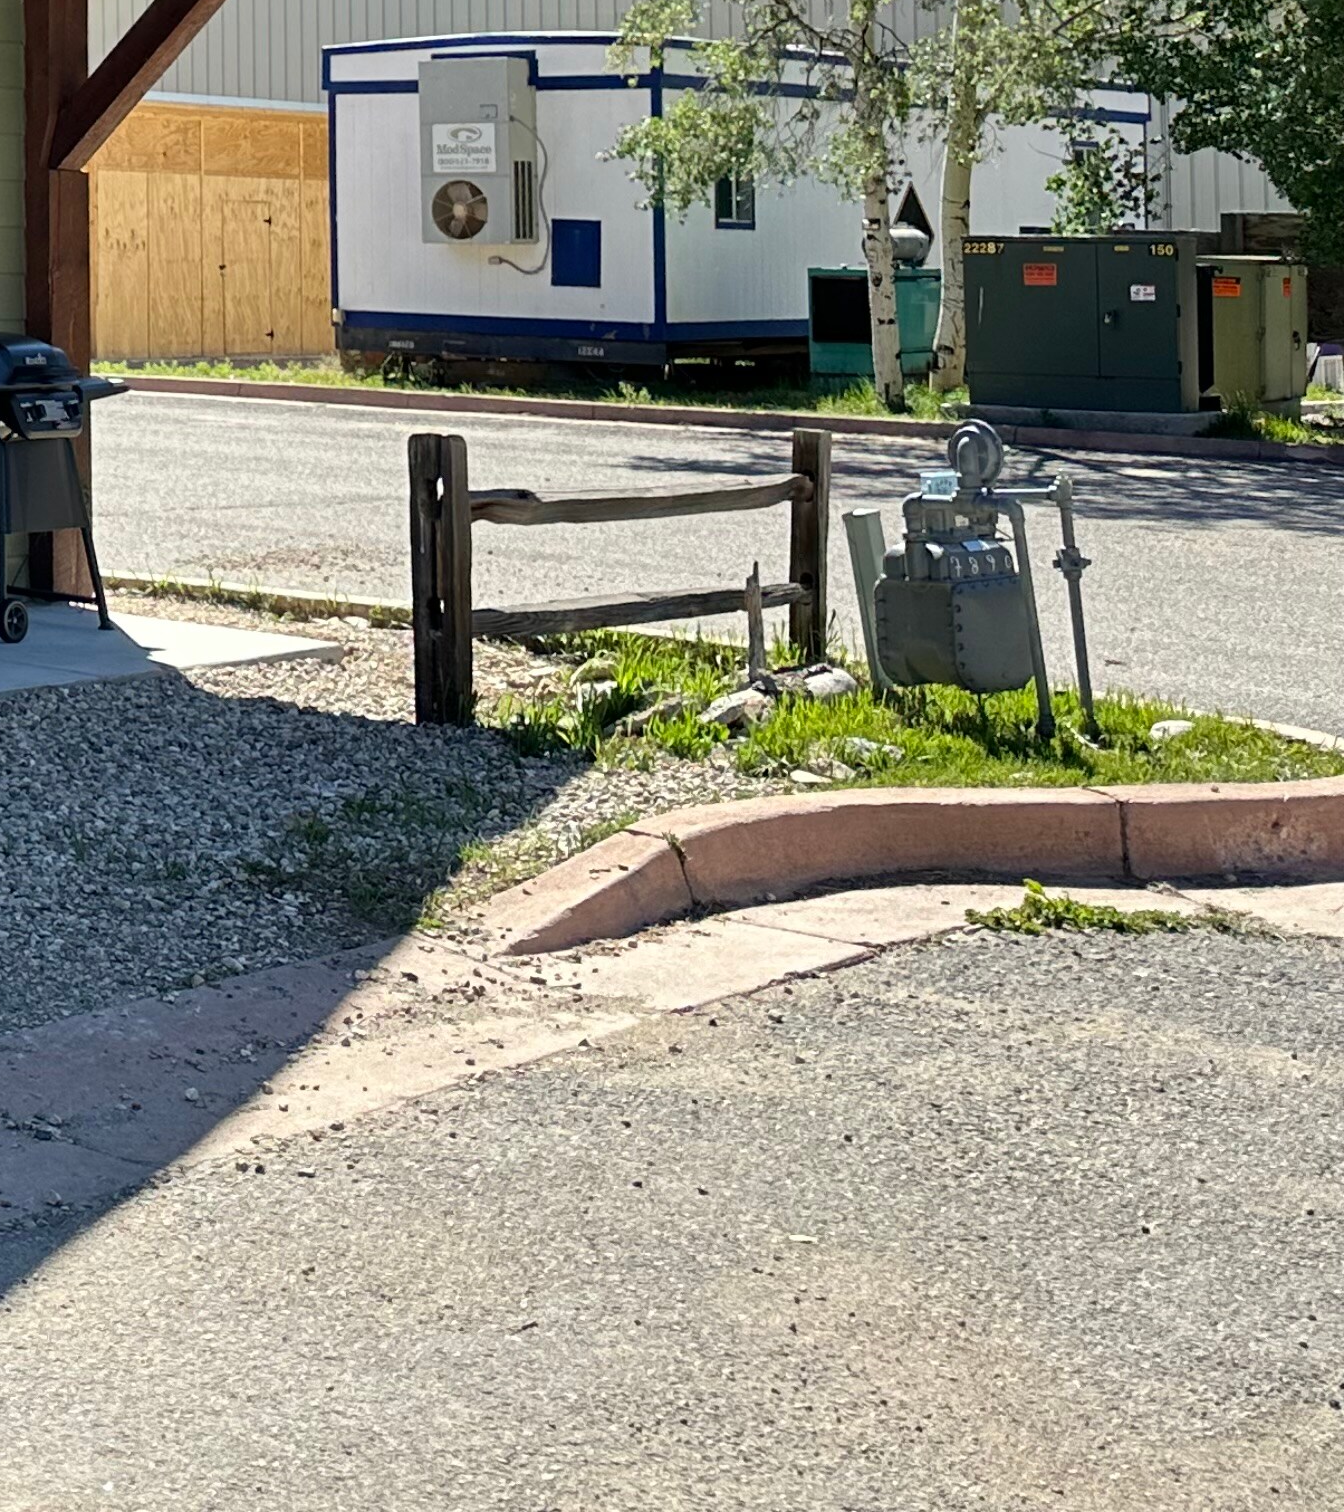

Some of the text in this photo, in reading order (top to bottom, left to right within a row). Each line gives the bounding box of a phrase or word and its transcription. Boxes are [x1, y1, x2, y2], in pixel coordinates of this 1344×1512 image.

[436, 143, 492, 157] ModSpace
[963, 241, 1005, 255] 22287
[1150, 243, 1174, 256] 150
